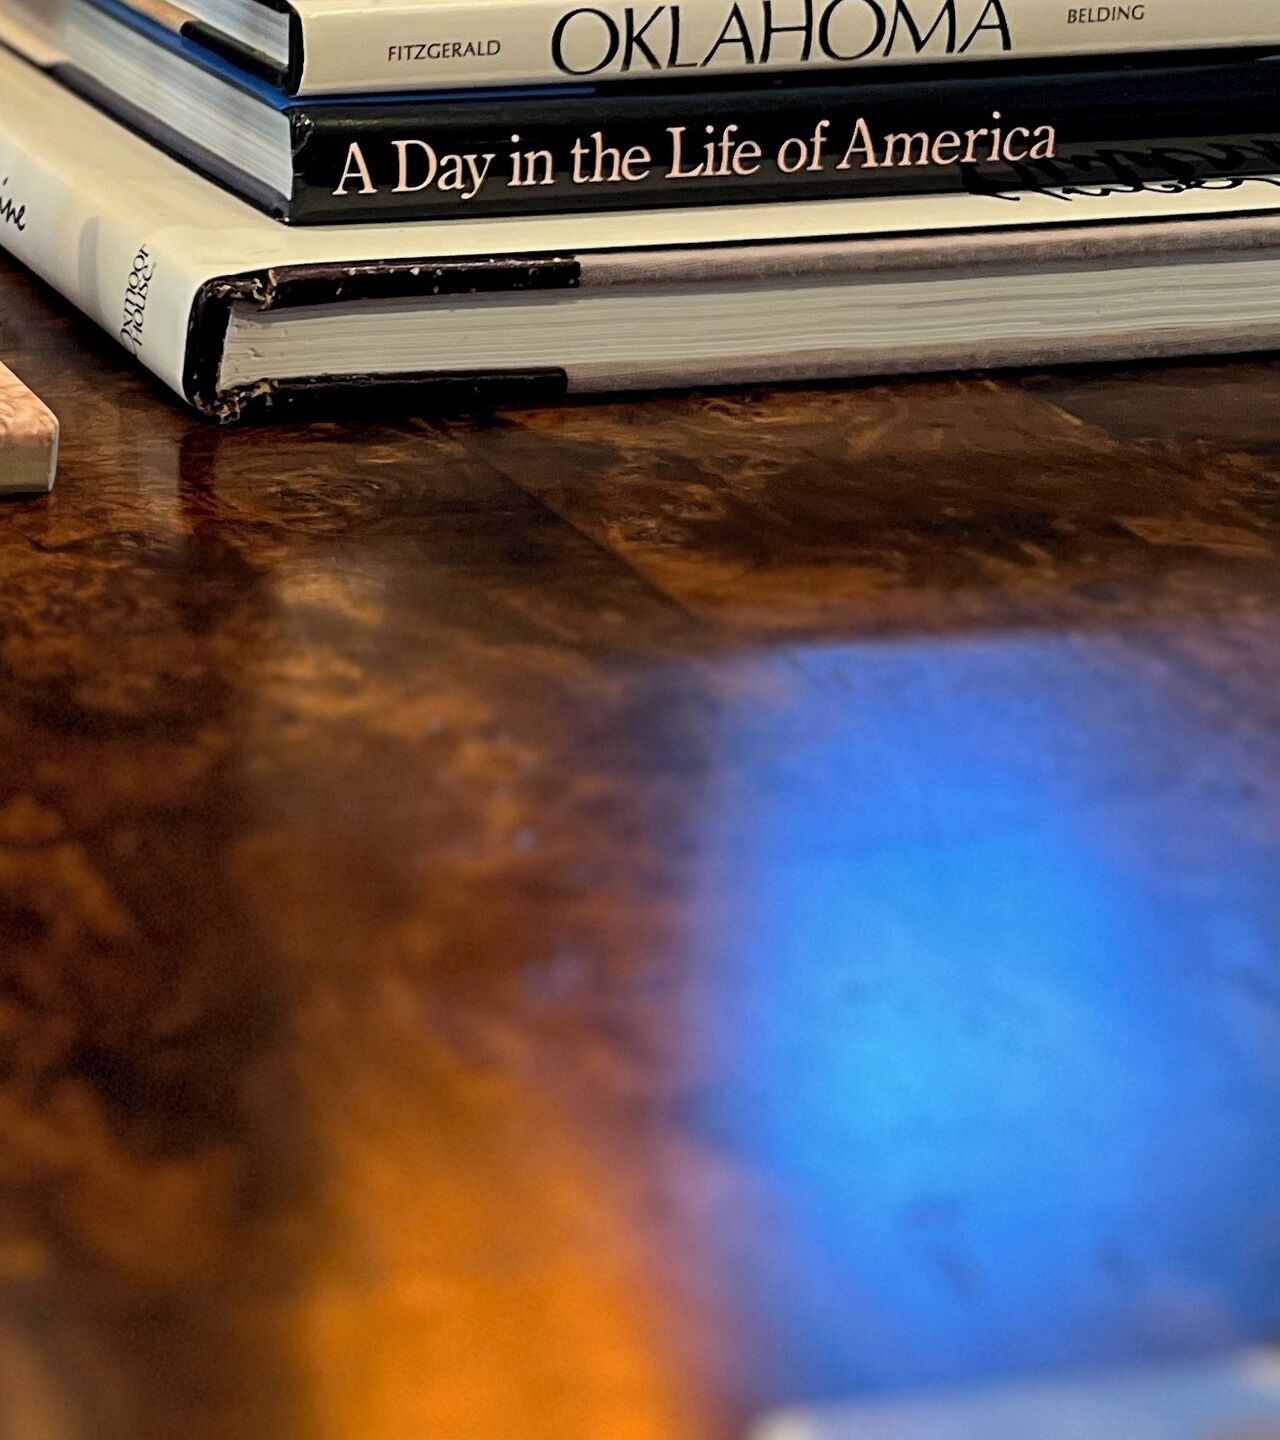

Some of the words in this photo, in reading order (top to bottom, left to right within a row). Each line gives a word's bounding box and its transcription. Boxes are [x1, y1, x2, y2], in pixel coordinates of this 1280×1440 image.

[1066, 4, 1146, 25] BELDING
[387, 39, 502, 62] FITZGERALD
[332, 141, 378, 196] A
[390, 139, 496, 201] Day
[506, 134, 556, 188] in
[570, 131, 652, 184] the
[664, 123, 763, 180] Life
[777, 119, 831, 174] of
[836, 110, 1058, 171] America
